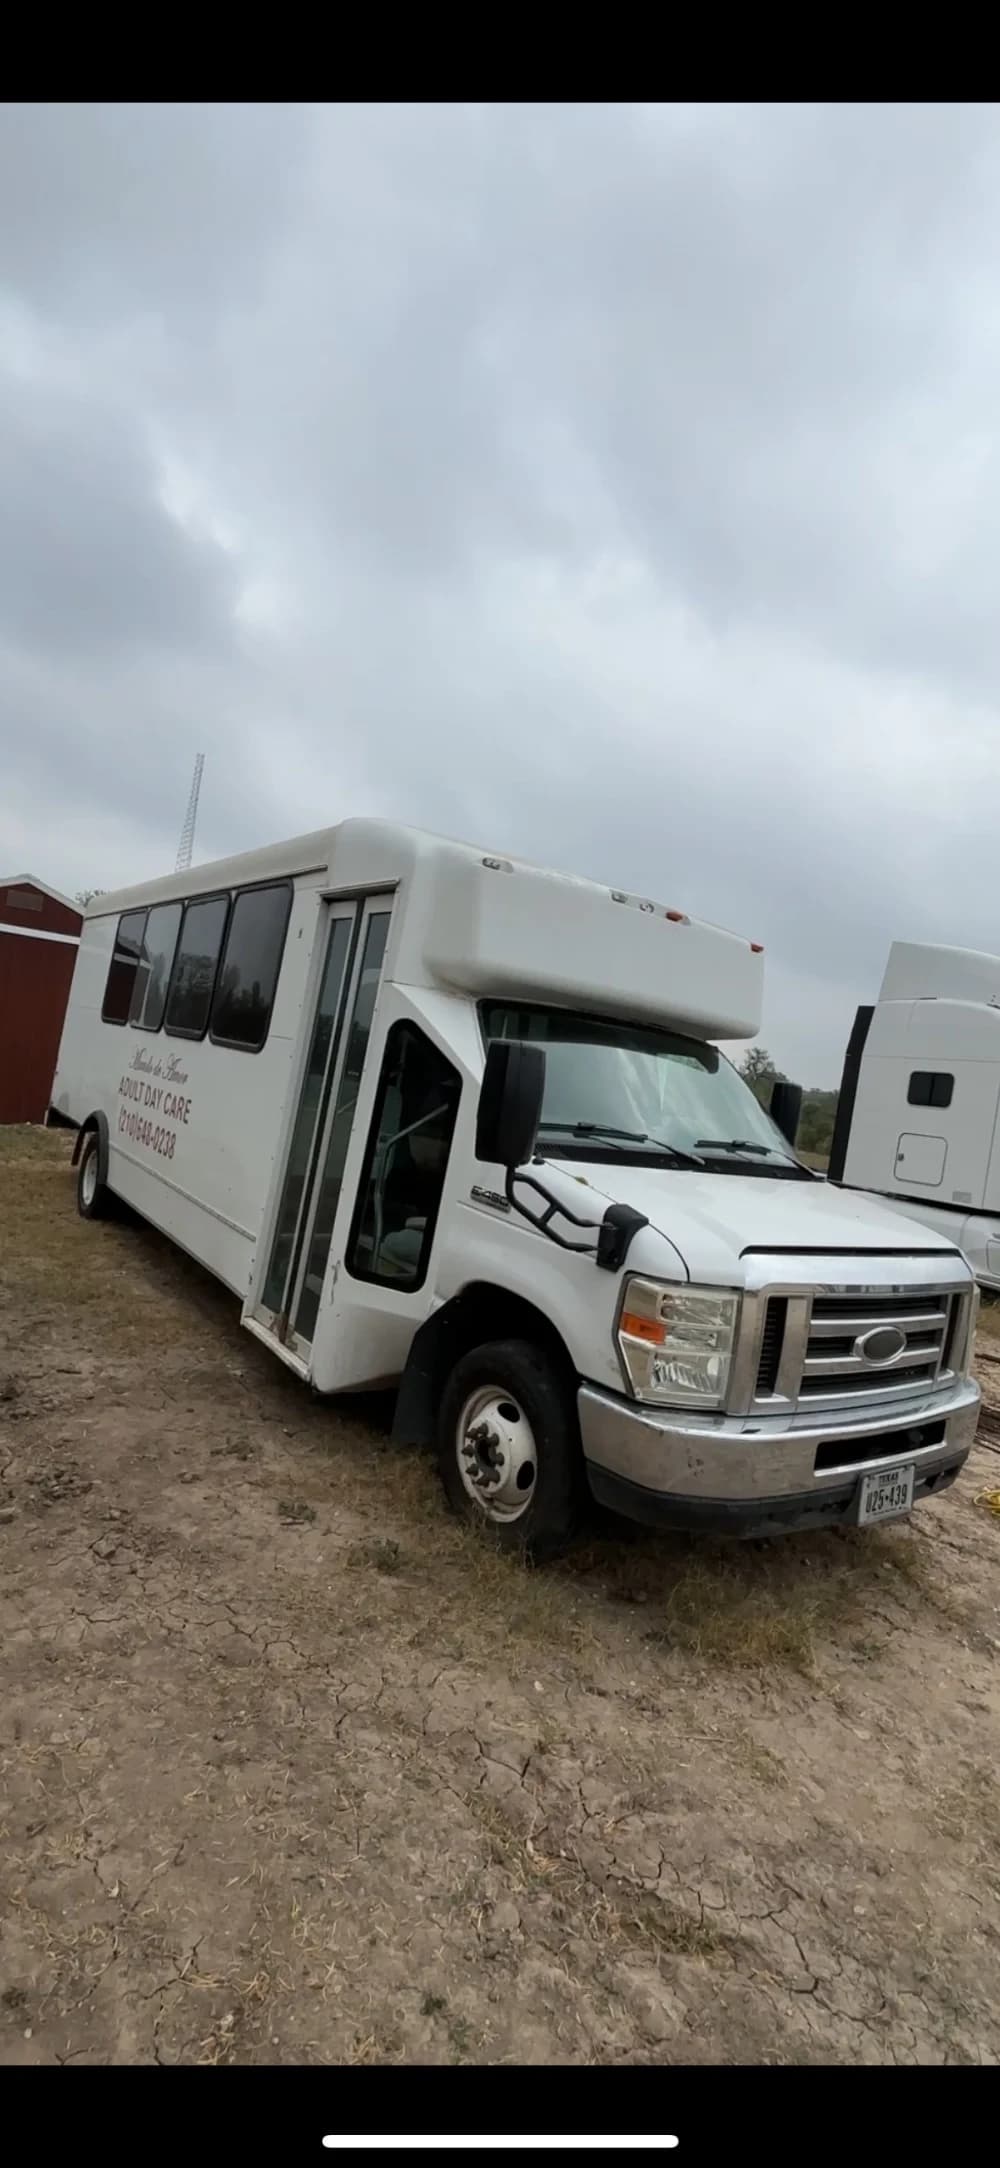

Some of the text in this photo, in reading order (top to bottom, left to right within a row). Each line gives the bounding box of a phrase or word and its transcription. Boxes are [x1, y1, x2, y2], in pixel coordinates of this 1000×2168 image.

[119, 1076, 192, 1125] ADULT DAY CARE
[879, 1472, 899, 1483] TEXAS
